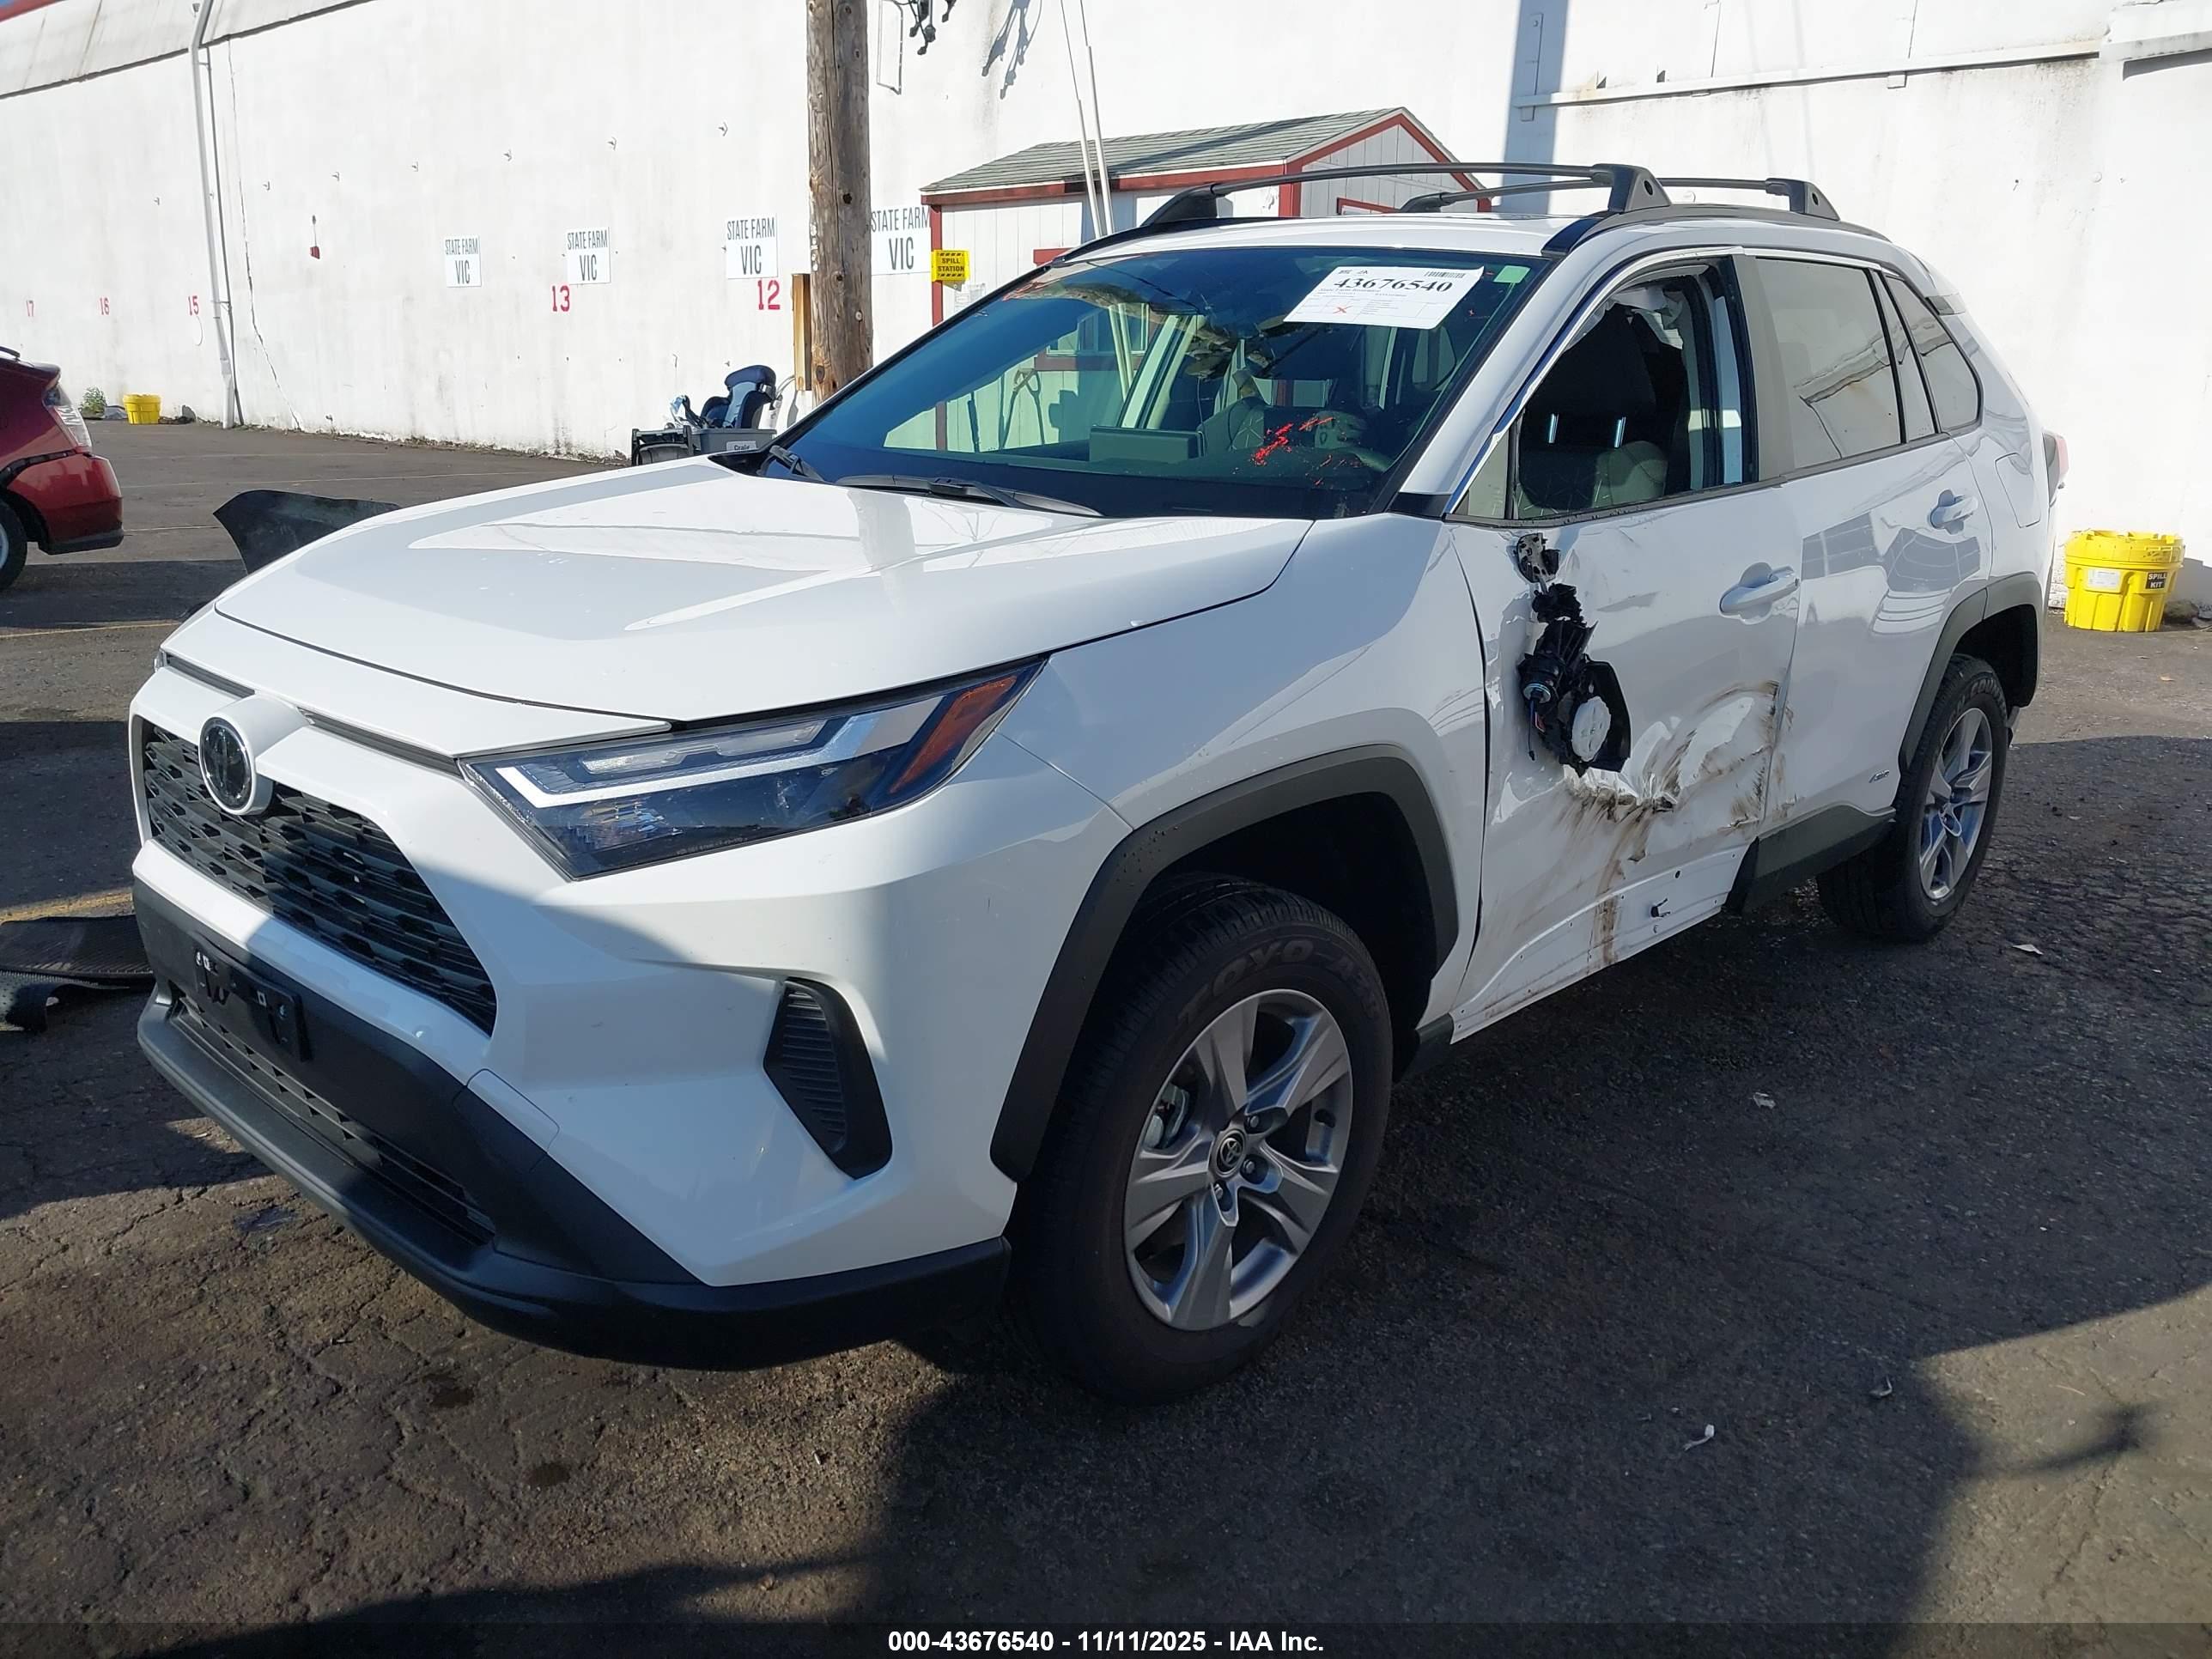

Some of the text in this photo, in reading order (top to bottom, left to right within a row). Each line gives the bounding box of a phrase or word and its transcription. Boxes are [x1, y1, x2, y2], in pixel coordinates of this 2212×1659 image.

[726, 217, 775, 240] STATE FARM
[872, 209, 899, 233] STATE
[445, 238, 478, 255] STATE FARM
[567, 229, 608, 250] STATE FARM
[740, 245, 762, 275] VIC
[889, 237, 915, 270] VIC
[455, 260, 471, 284] VIC
[580, 254, 598, 281] VIC
[757, 280, 781, 310] 12
[1334, 277, 1453, 294] 43676540
[26, 301, 34, 317] 17
[99, 298, 110, 315] 16
[188, 295, 199, 315] 15
[552, 285, 570, 312] 13
[1176, 939, 1315, 1027] TOYO
